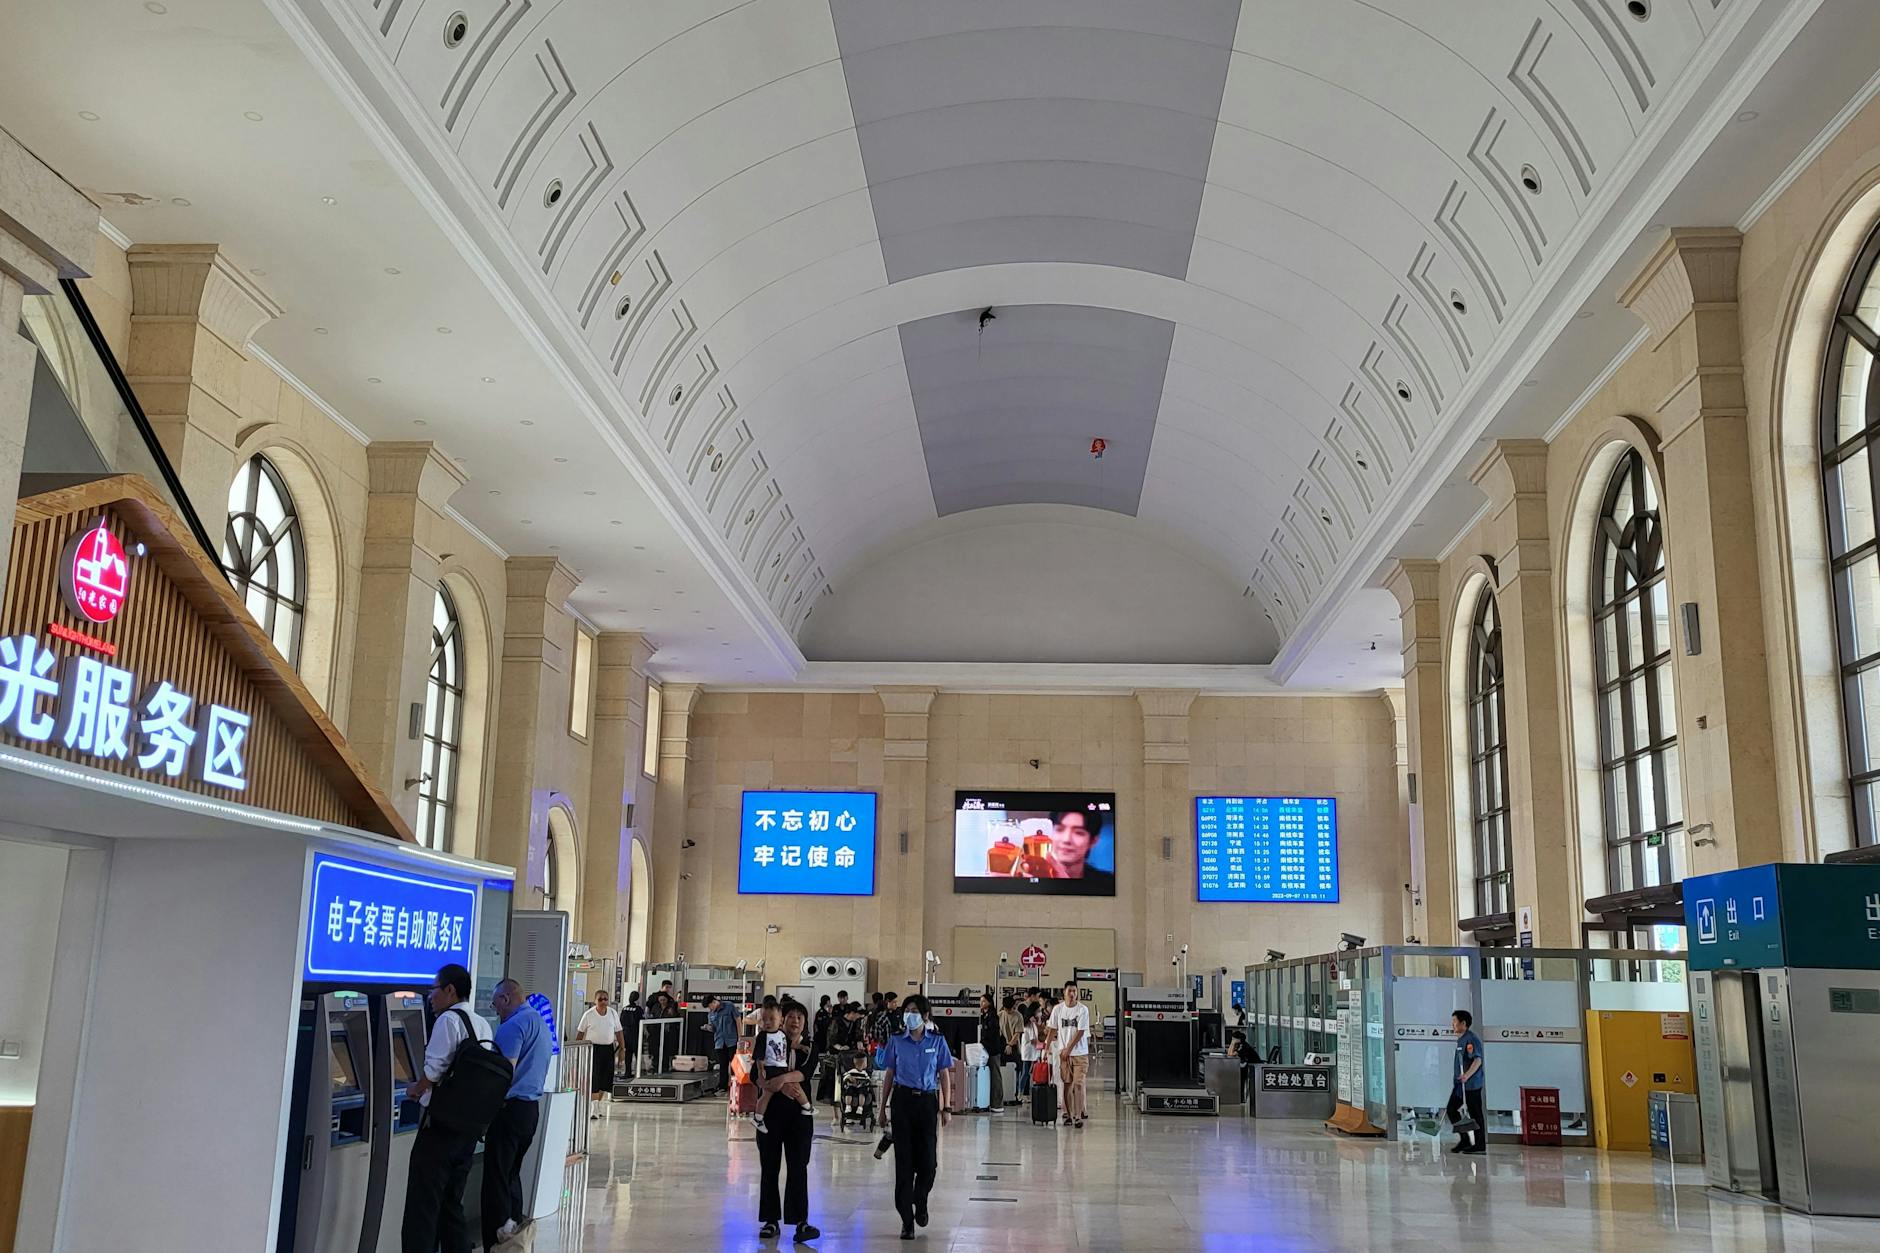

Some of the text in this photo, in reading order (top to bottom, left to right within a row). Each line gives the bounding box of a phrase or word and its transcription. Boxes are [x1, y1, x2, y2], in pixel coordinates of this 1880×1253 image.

[754, 808, 857, 833] 不忘初心
[753, 844, 857, 868] 牢记使命
[1726, 896, 1765, 924] 出口
[327, 895, 465, 952] 电子客票自助服务区
[1728, 930, 1740, 941] Exit
[1868, 928, 1880, 940] E
[1265, 1072, 1326, 1088] 安检处置台
